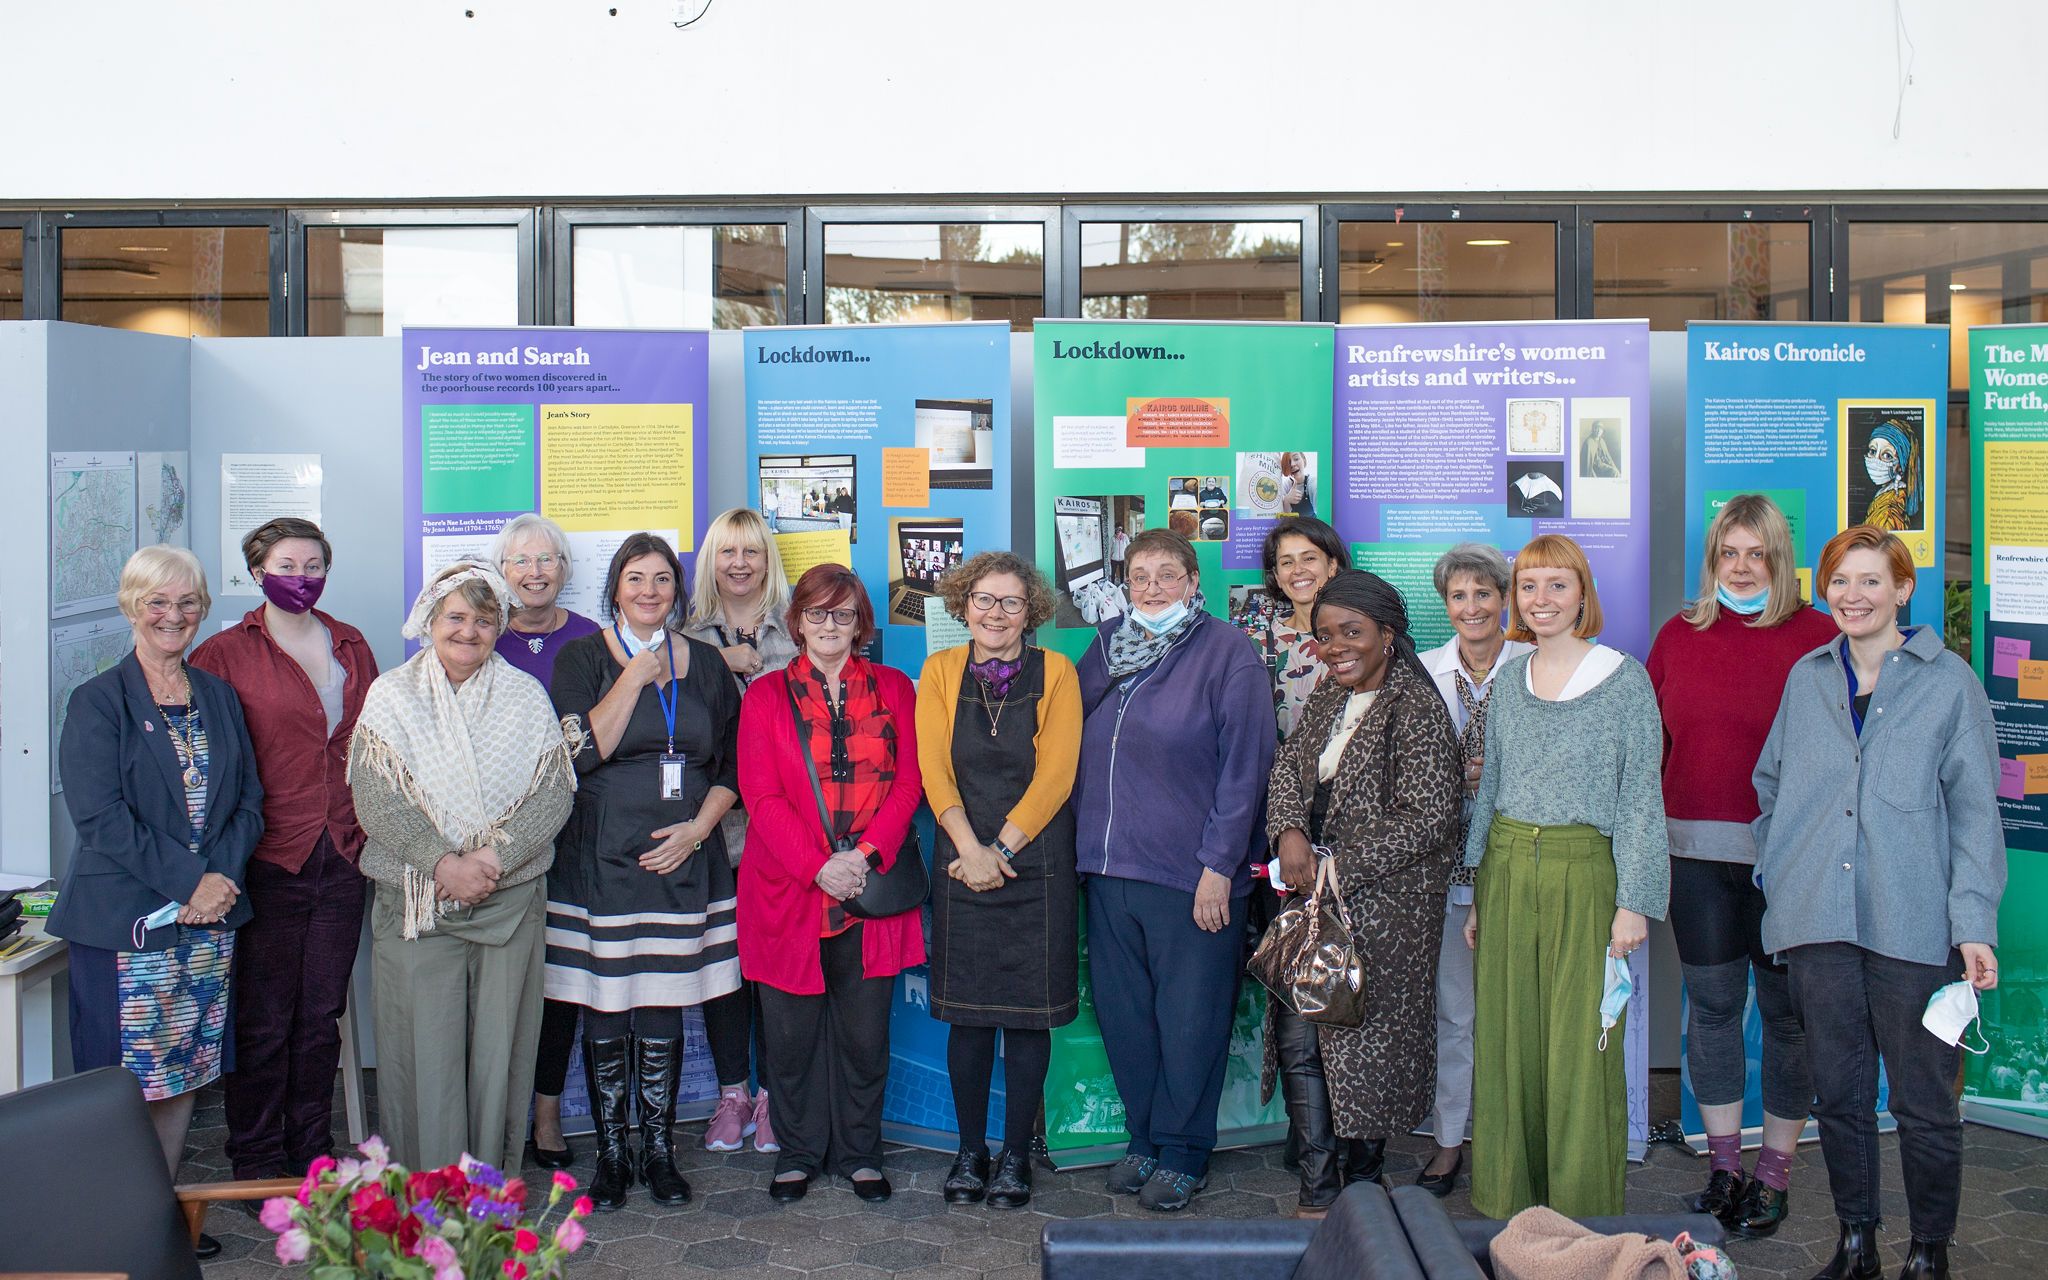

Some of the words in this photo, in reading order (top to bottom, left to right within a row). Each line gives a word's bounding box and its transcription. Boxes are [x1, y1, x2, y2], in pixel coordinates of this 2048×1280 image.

[417, 346, 471, 370] Jean
[477, 347, 519, 365] and
[524, 346, 590, 365] Sarah
[758, 346, 871, 363] Lockdown...
[1053, 341, 1185, 360] Lockdown...
[1521, 346, 1606, 361] women
[1705, 342, 1770, 361] Kairos
[1774, 342, 1865, 362] Chronicle
[1984, 345, 2025, 363] The
[422, 373, 443, 381] The
[444, 374, 469, 384] story
[472, 373, 484, 381] of
[543, 373, 595, 381] discovered
[597, 373, 607, 381] in
[1348, 368, 1419, 387] artists
[1425, 367, 1467, 386] and
[422, 384, 438, 392] the
[440, 384, 494, 394] poorhouse
[497, 384, 534, 392] records
[538, 384, 554, 392] 100
[557, 385, 584, 393] years
[570, 412, 590, 420] Story
[1058, 499, 1090, 508] KAIROS
